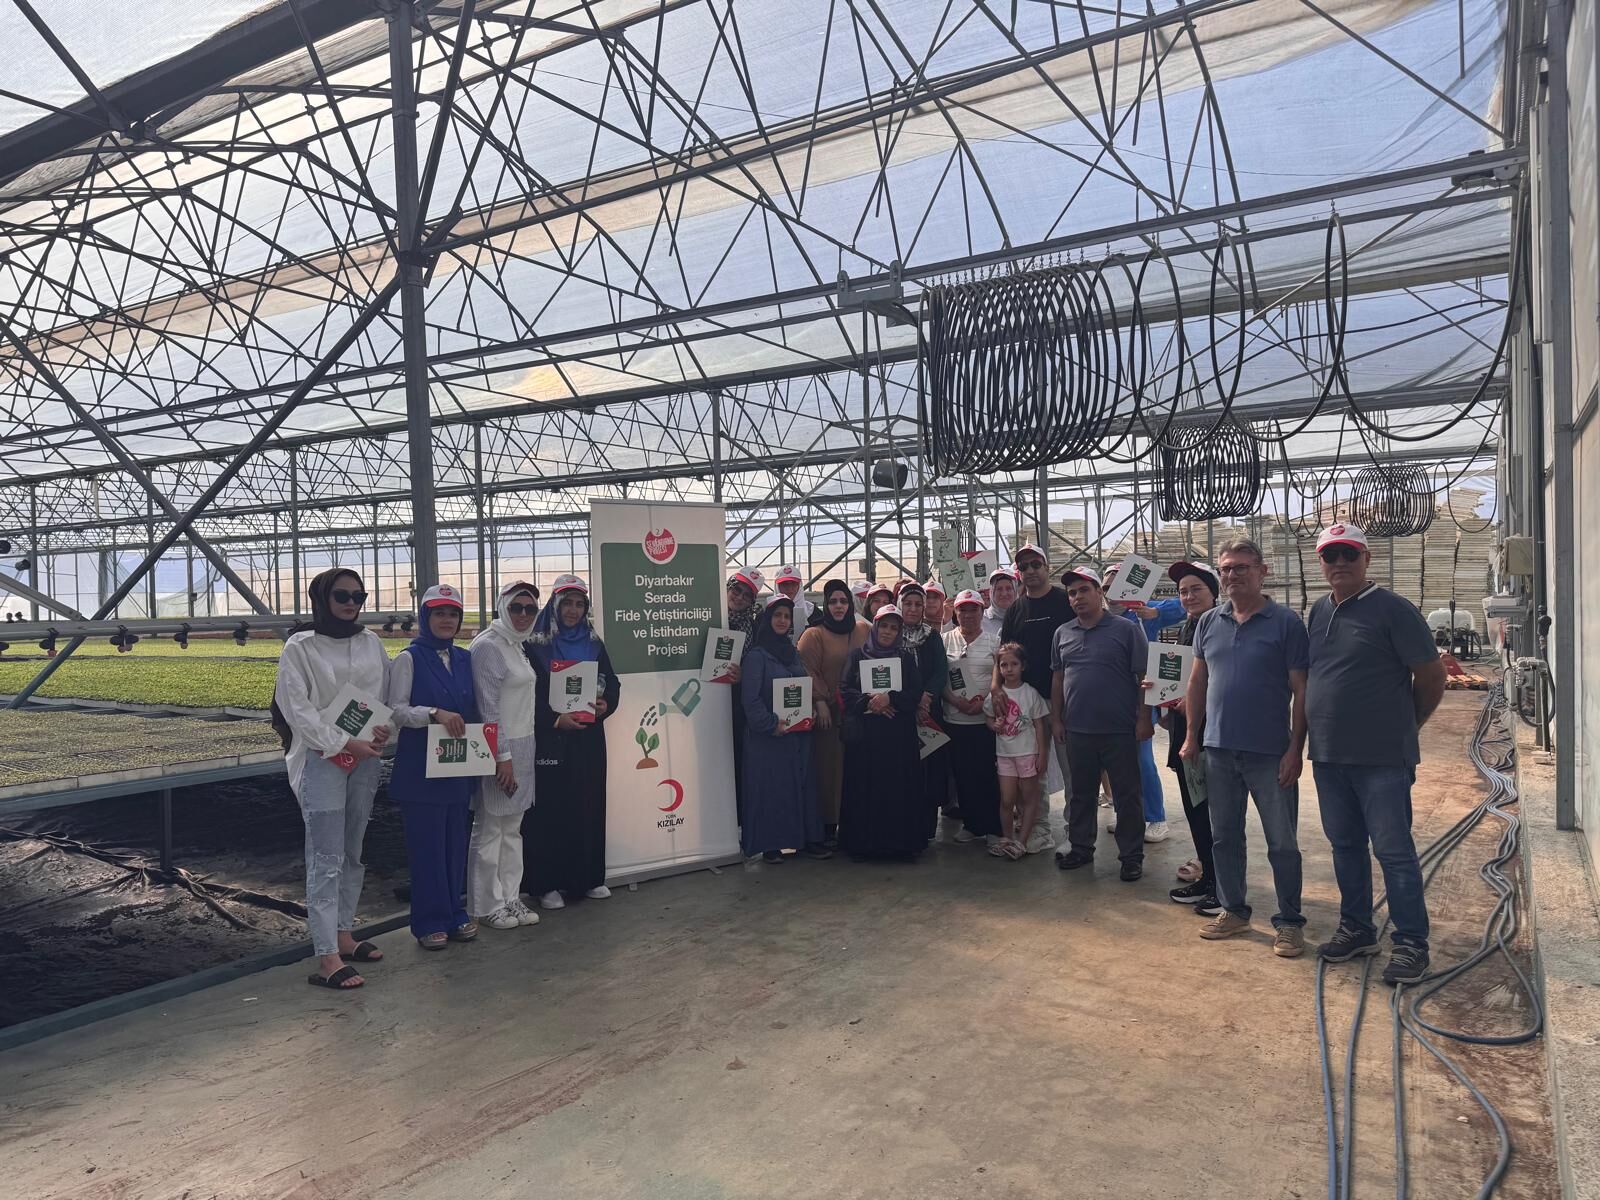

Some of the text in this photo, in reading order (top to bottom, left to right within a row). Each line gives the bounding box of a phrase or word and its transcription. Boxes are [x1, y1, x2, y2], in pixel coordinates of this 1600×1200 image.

[634, 574, 694, 589] Diyarbakır
[644, 591, 686, 604] Serada
[614, 607, 712, 623] Fide Yetiştiriciliği
[633, 623, 699, 639] ve İstihdam
[647, 642, 688, 657] Projesi
[657, 817, 684, 828] KIZILAY
